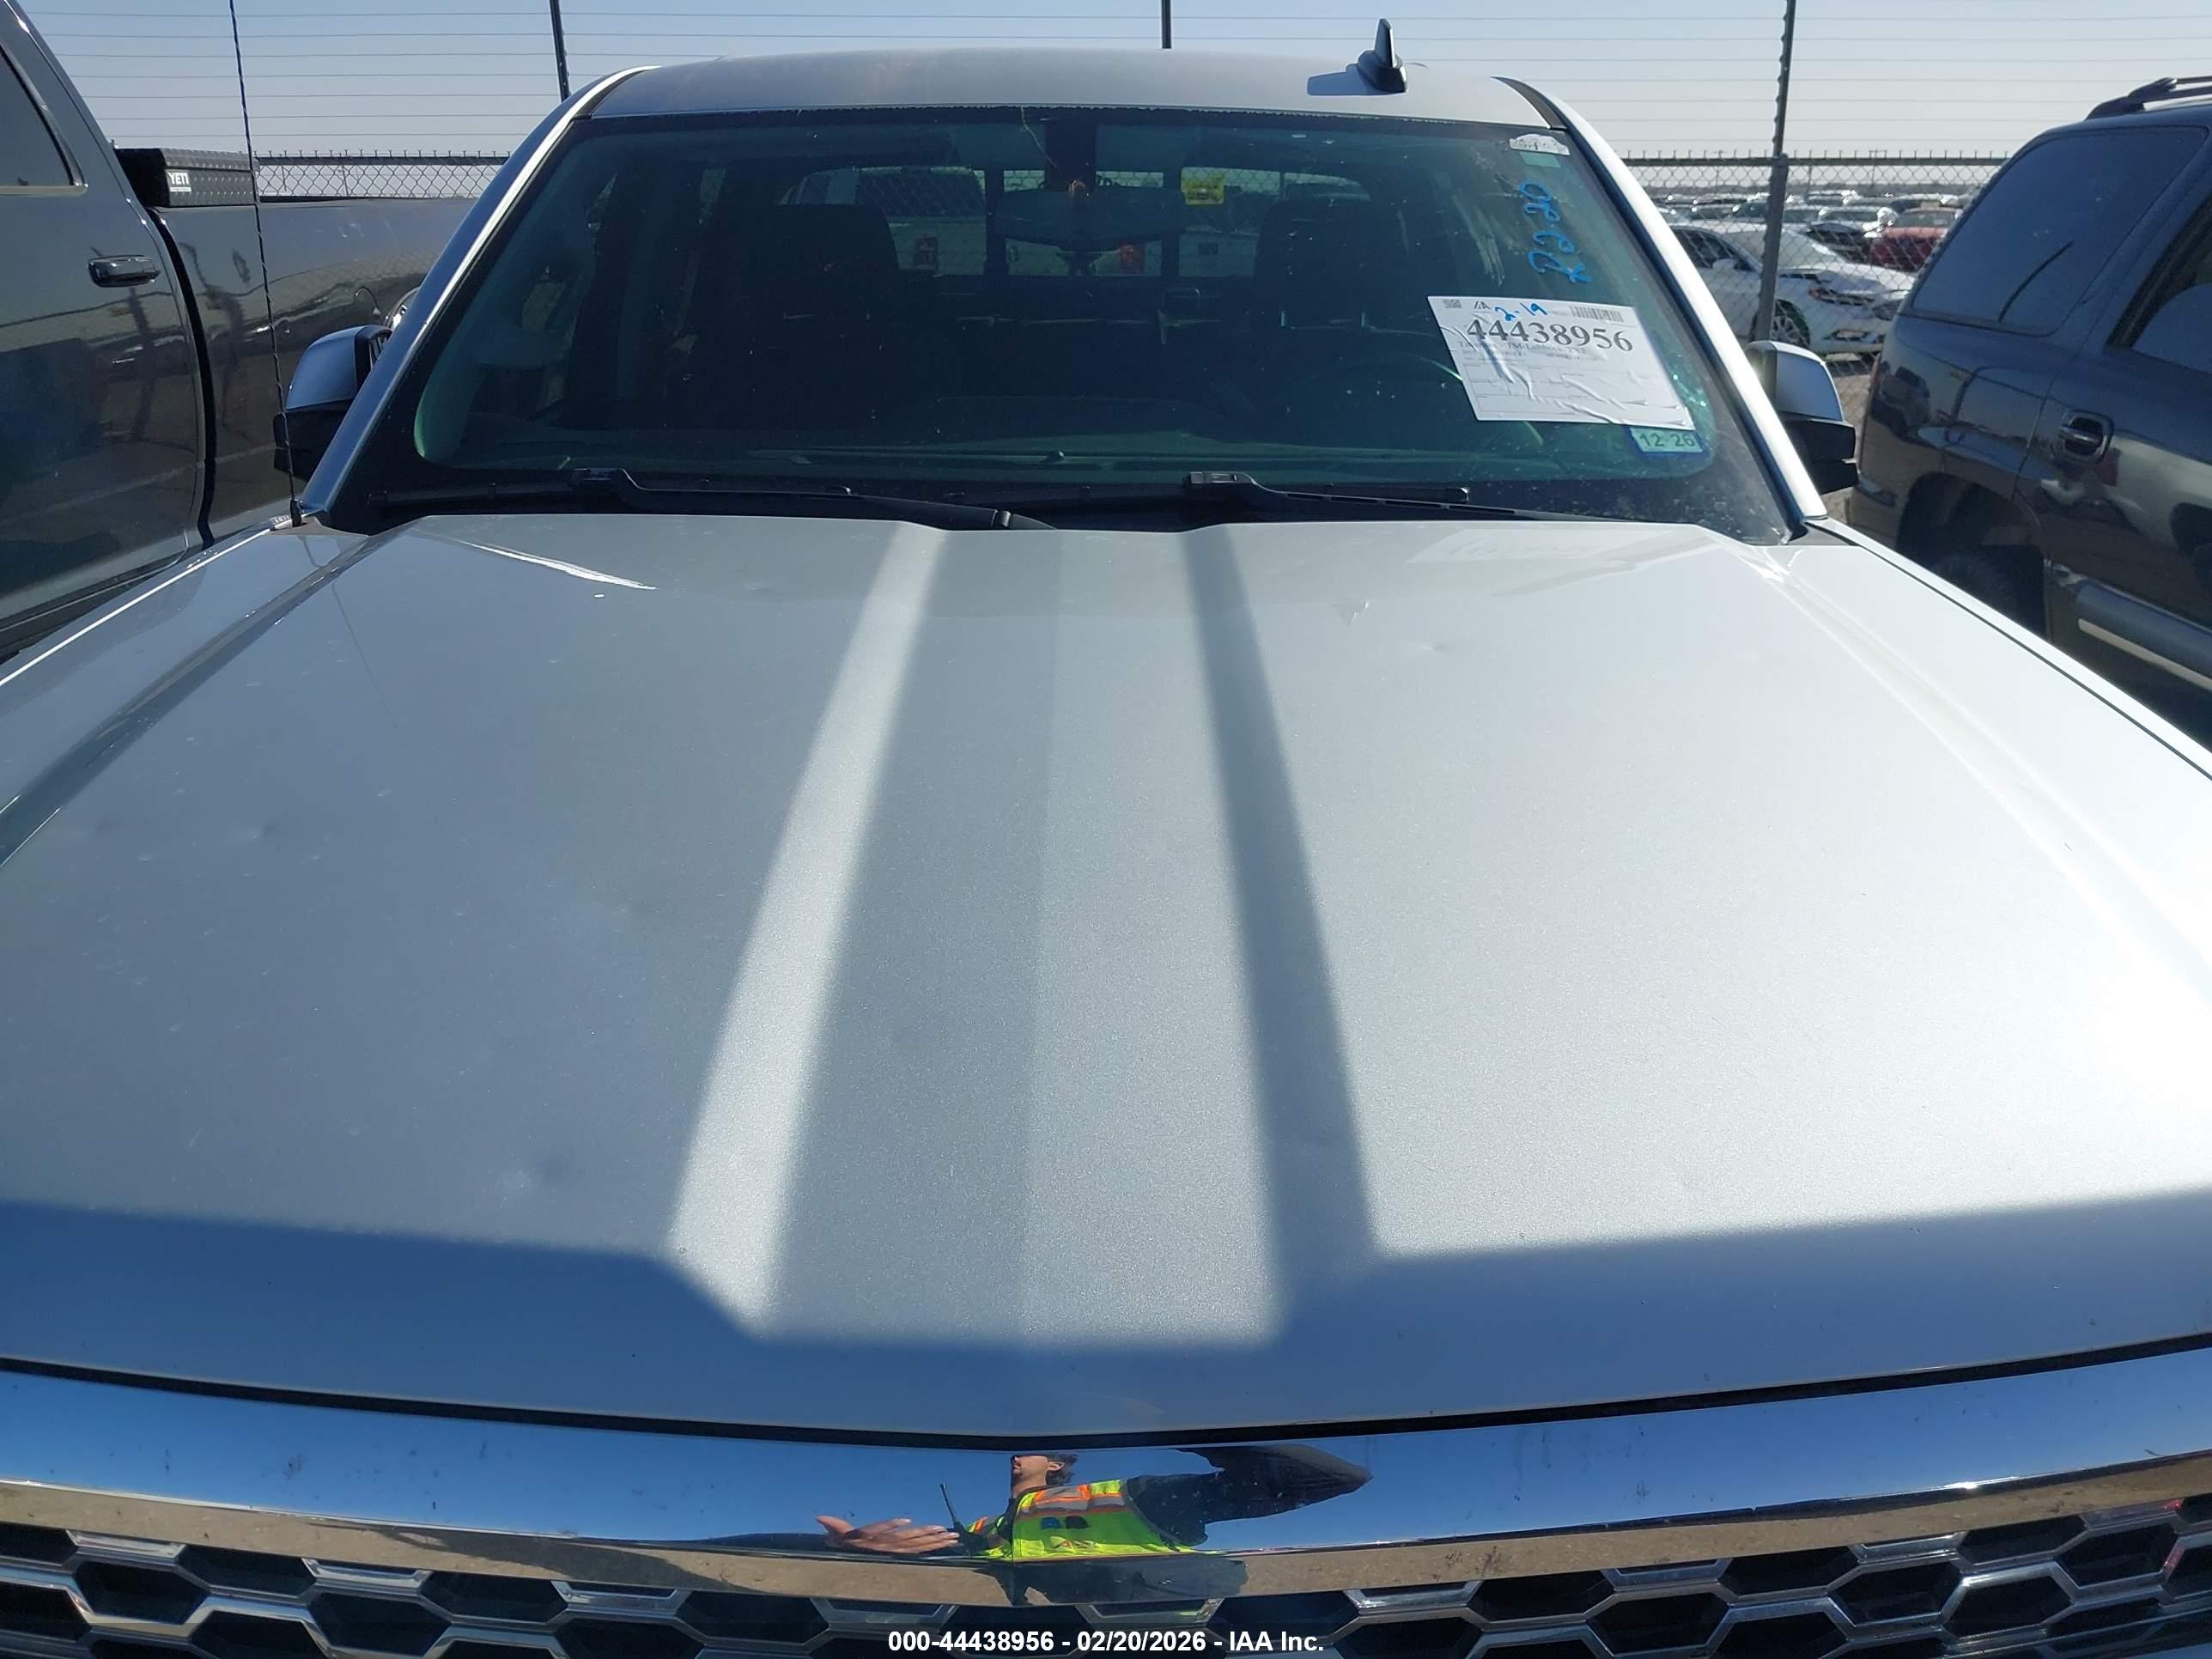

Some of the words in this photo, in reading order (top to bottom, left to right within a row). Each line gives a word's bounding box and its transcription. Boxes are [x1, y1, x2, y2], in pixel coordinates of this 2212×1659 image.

[167, 172, 190, 185] YETI
[1467, 319, 1633, 352] 44438956
[1640, 433, 1695, 447] 12-26
